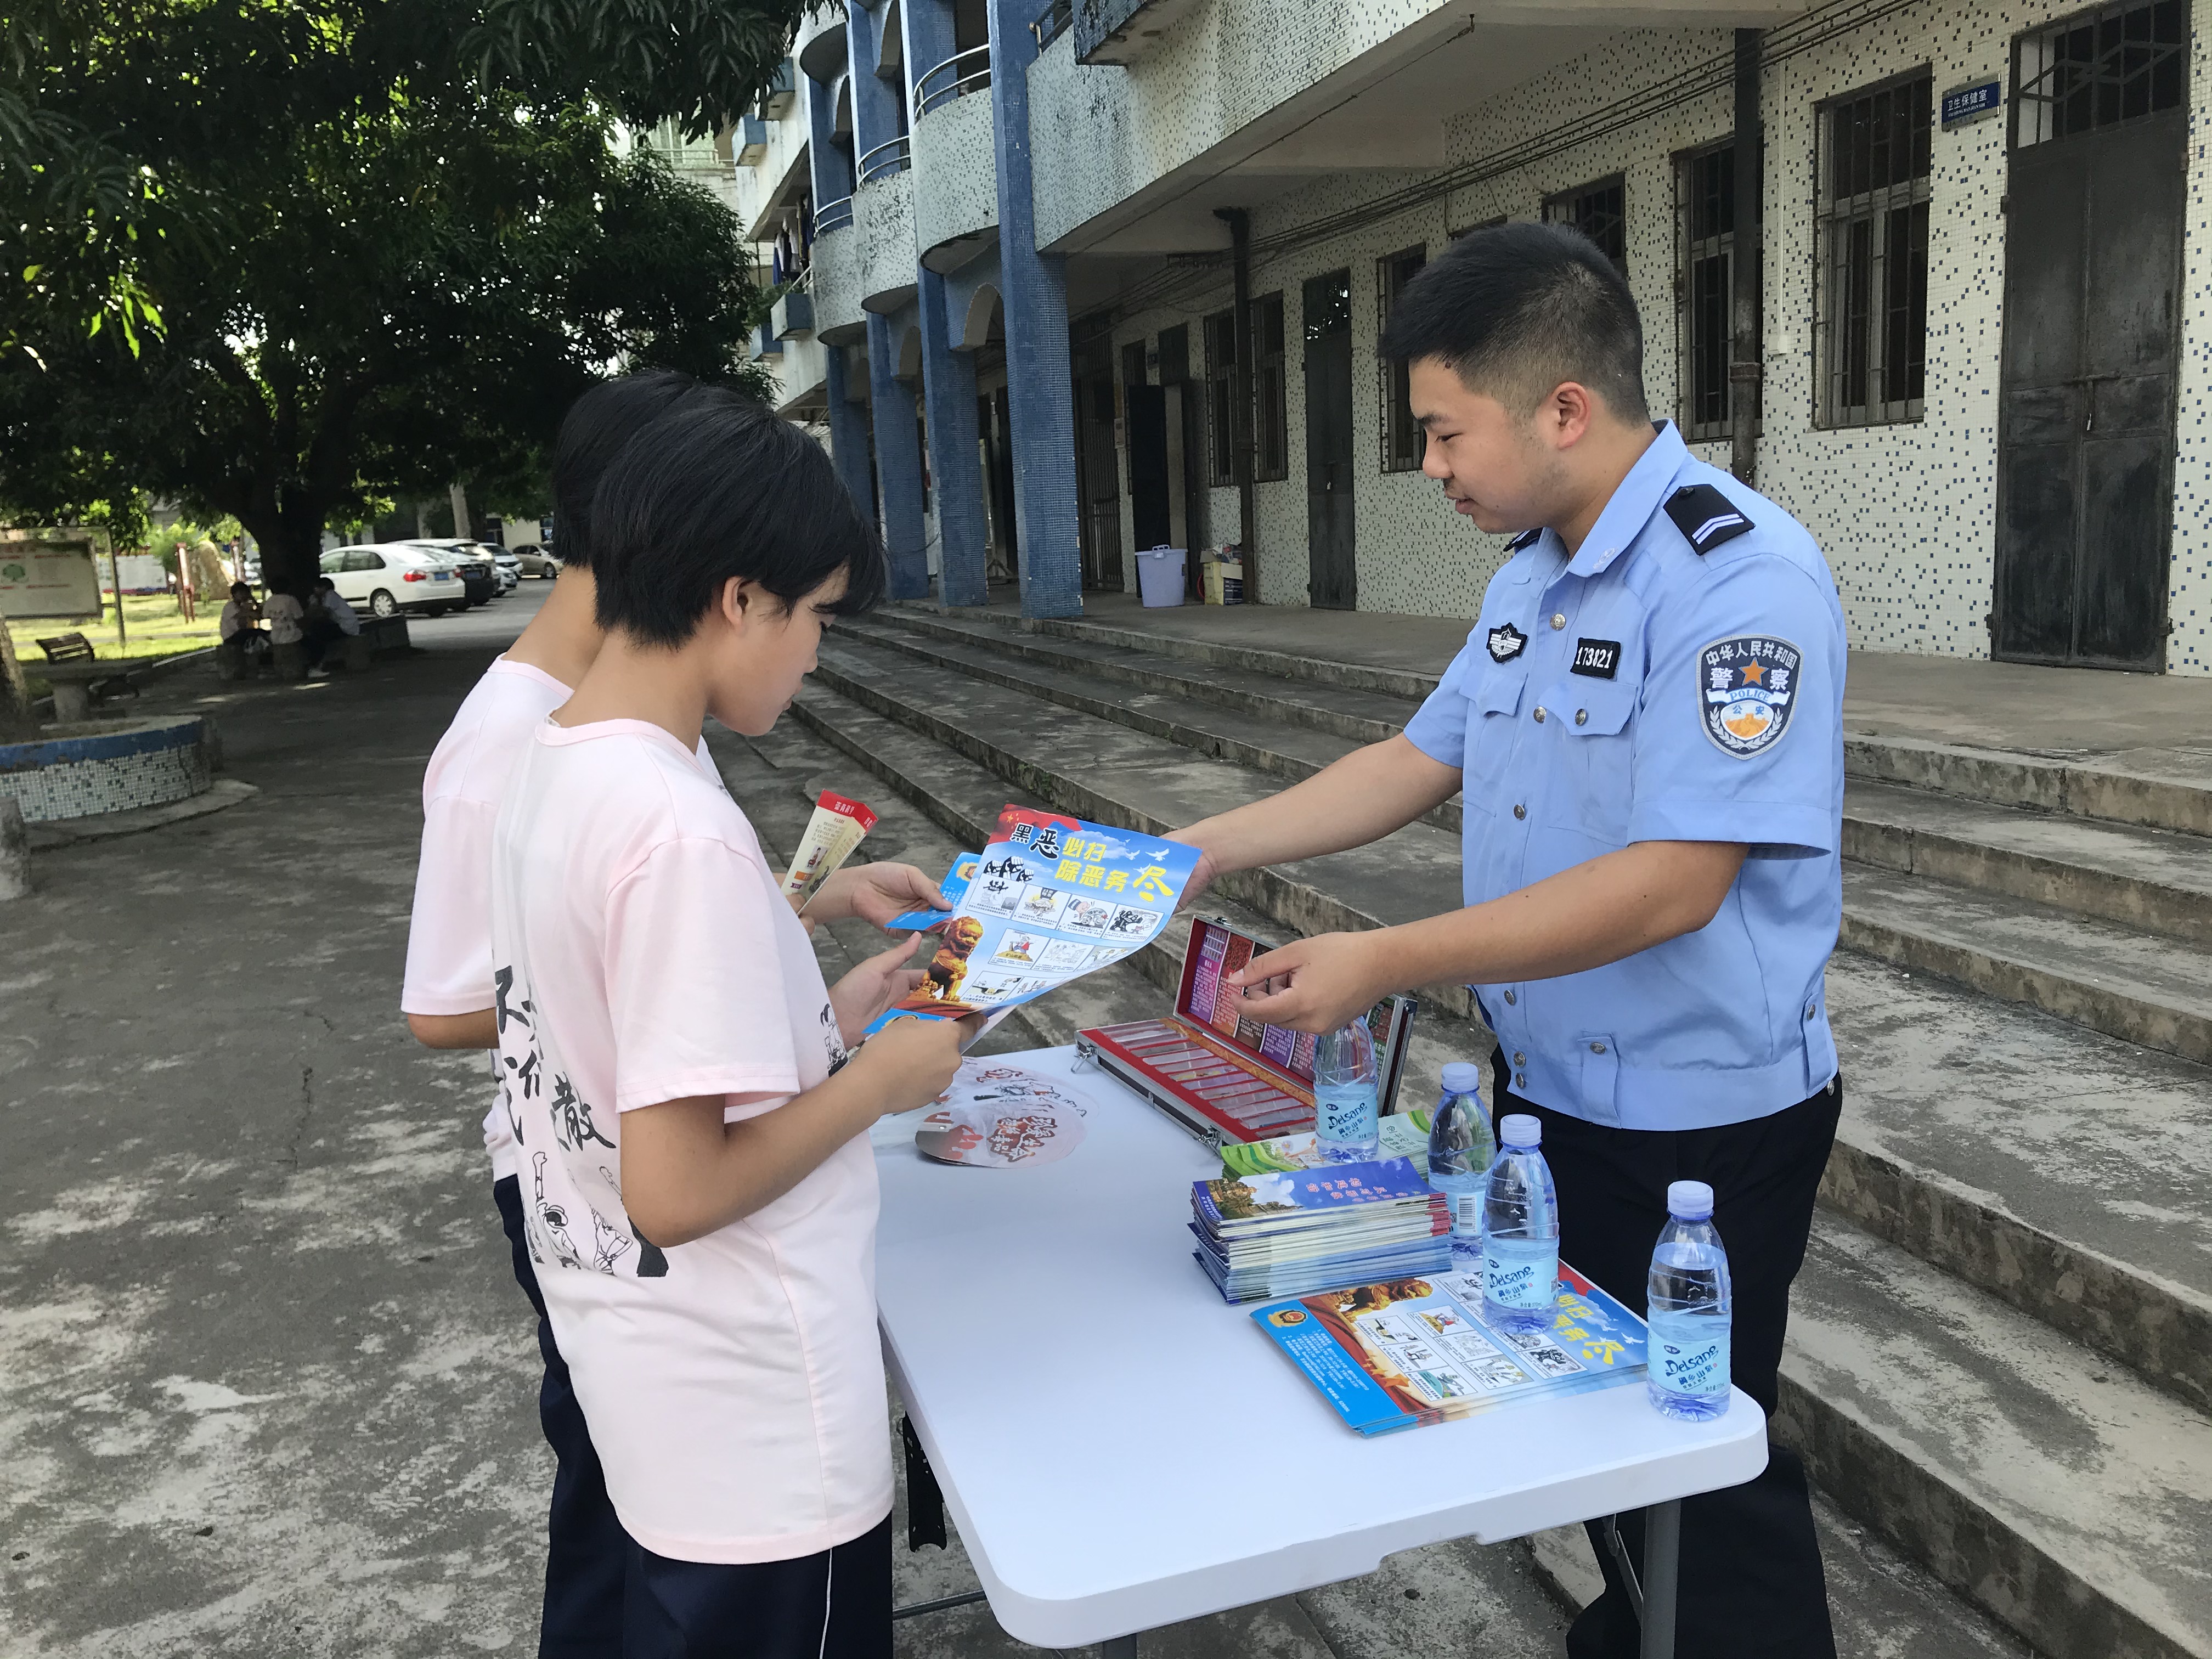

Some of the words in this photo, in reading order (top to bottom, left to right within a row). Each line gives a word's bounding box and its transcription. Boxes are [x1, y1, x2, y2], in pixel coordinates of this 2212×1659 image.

[1947, 89, 1987, 111] 卫生保健室
[1575, 646, 1613, 669] 173821
[1706, 641, 1798, 670] 中华人民共和国
[1729, 689, 1770, 701] POLICE
[1054, 859, 1175, 902] 除恶务尽
